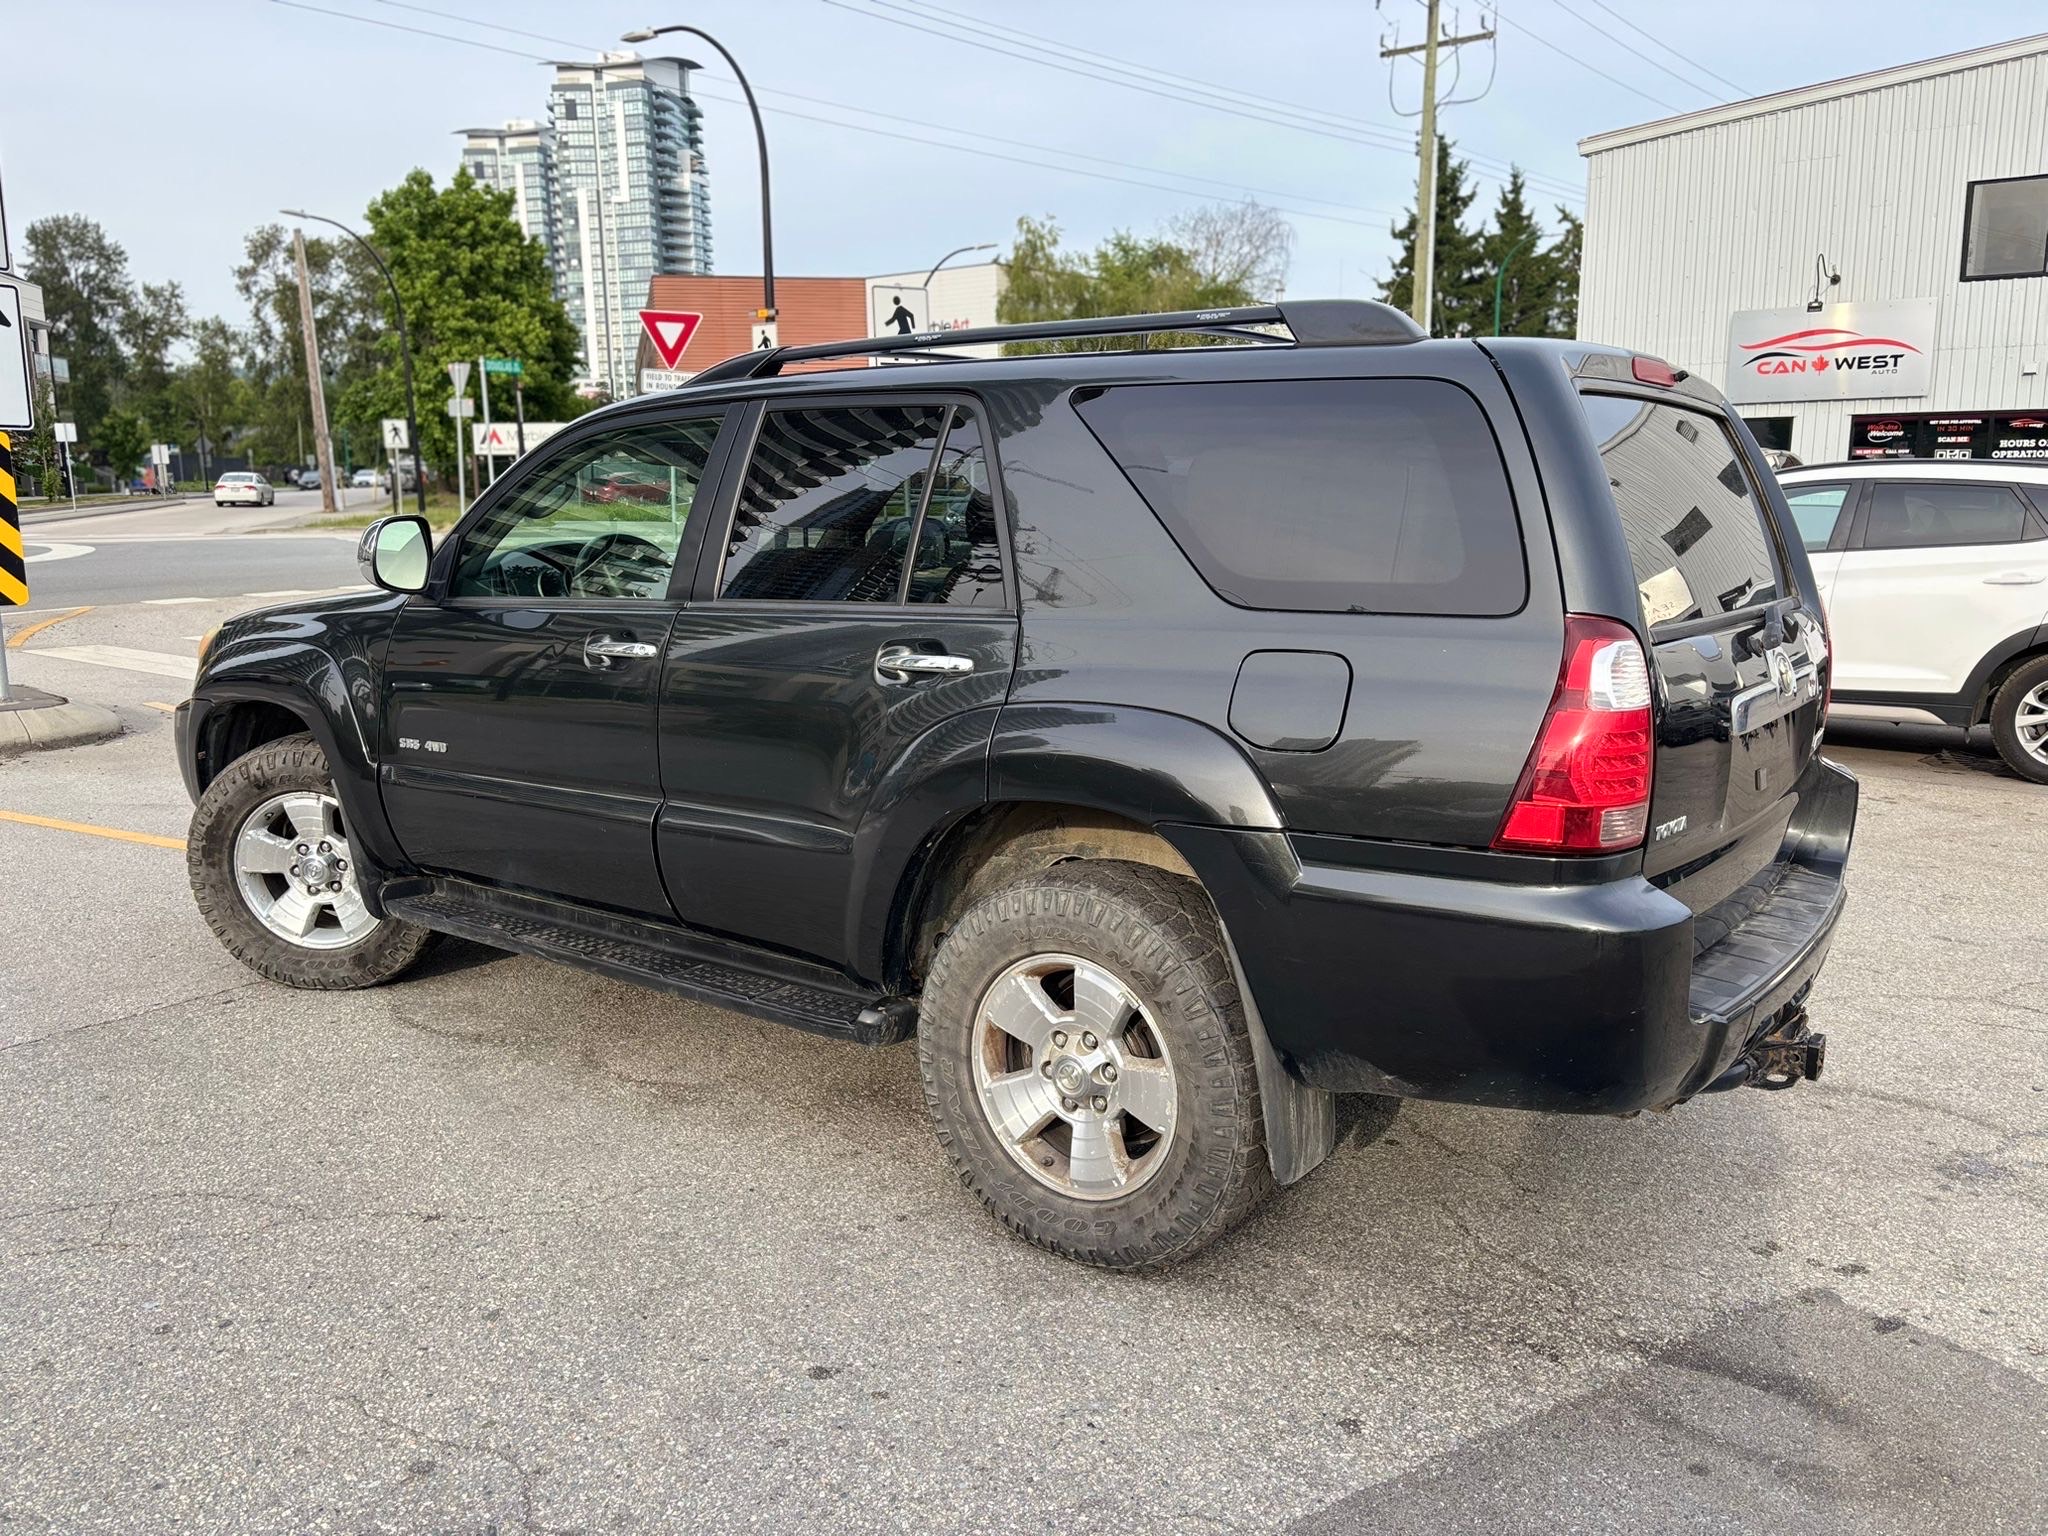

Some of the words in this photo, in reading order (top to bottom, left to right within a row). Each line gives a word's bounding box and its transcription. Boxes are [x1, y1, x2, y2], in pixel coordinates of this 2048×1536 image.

[1757, 359, 1806, 375] CAN
[1835, 353, 1906, 371] WEST
[646, 373, 662, 381] YIELD
[664, 374, 672, 382] TO
[1999, 439, 2036, 448] HOURS
[2038, 439, 2048, 447] O
